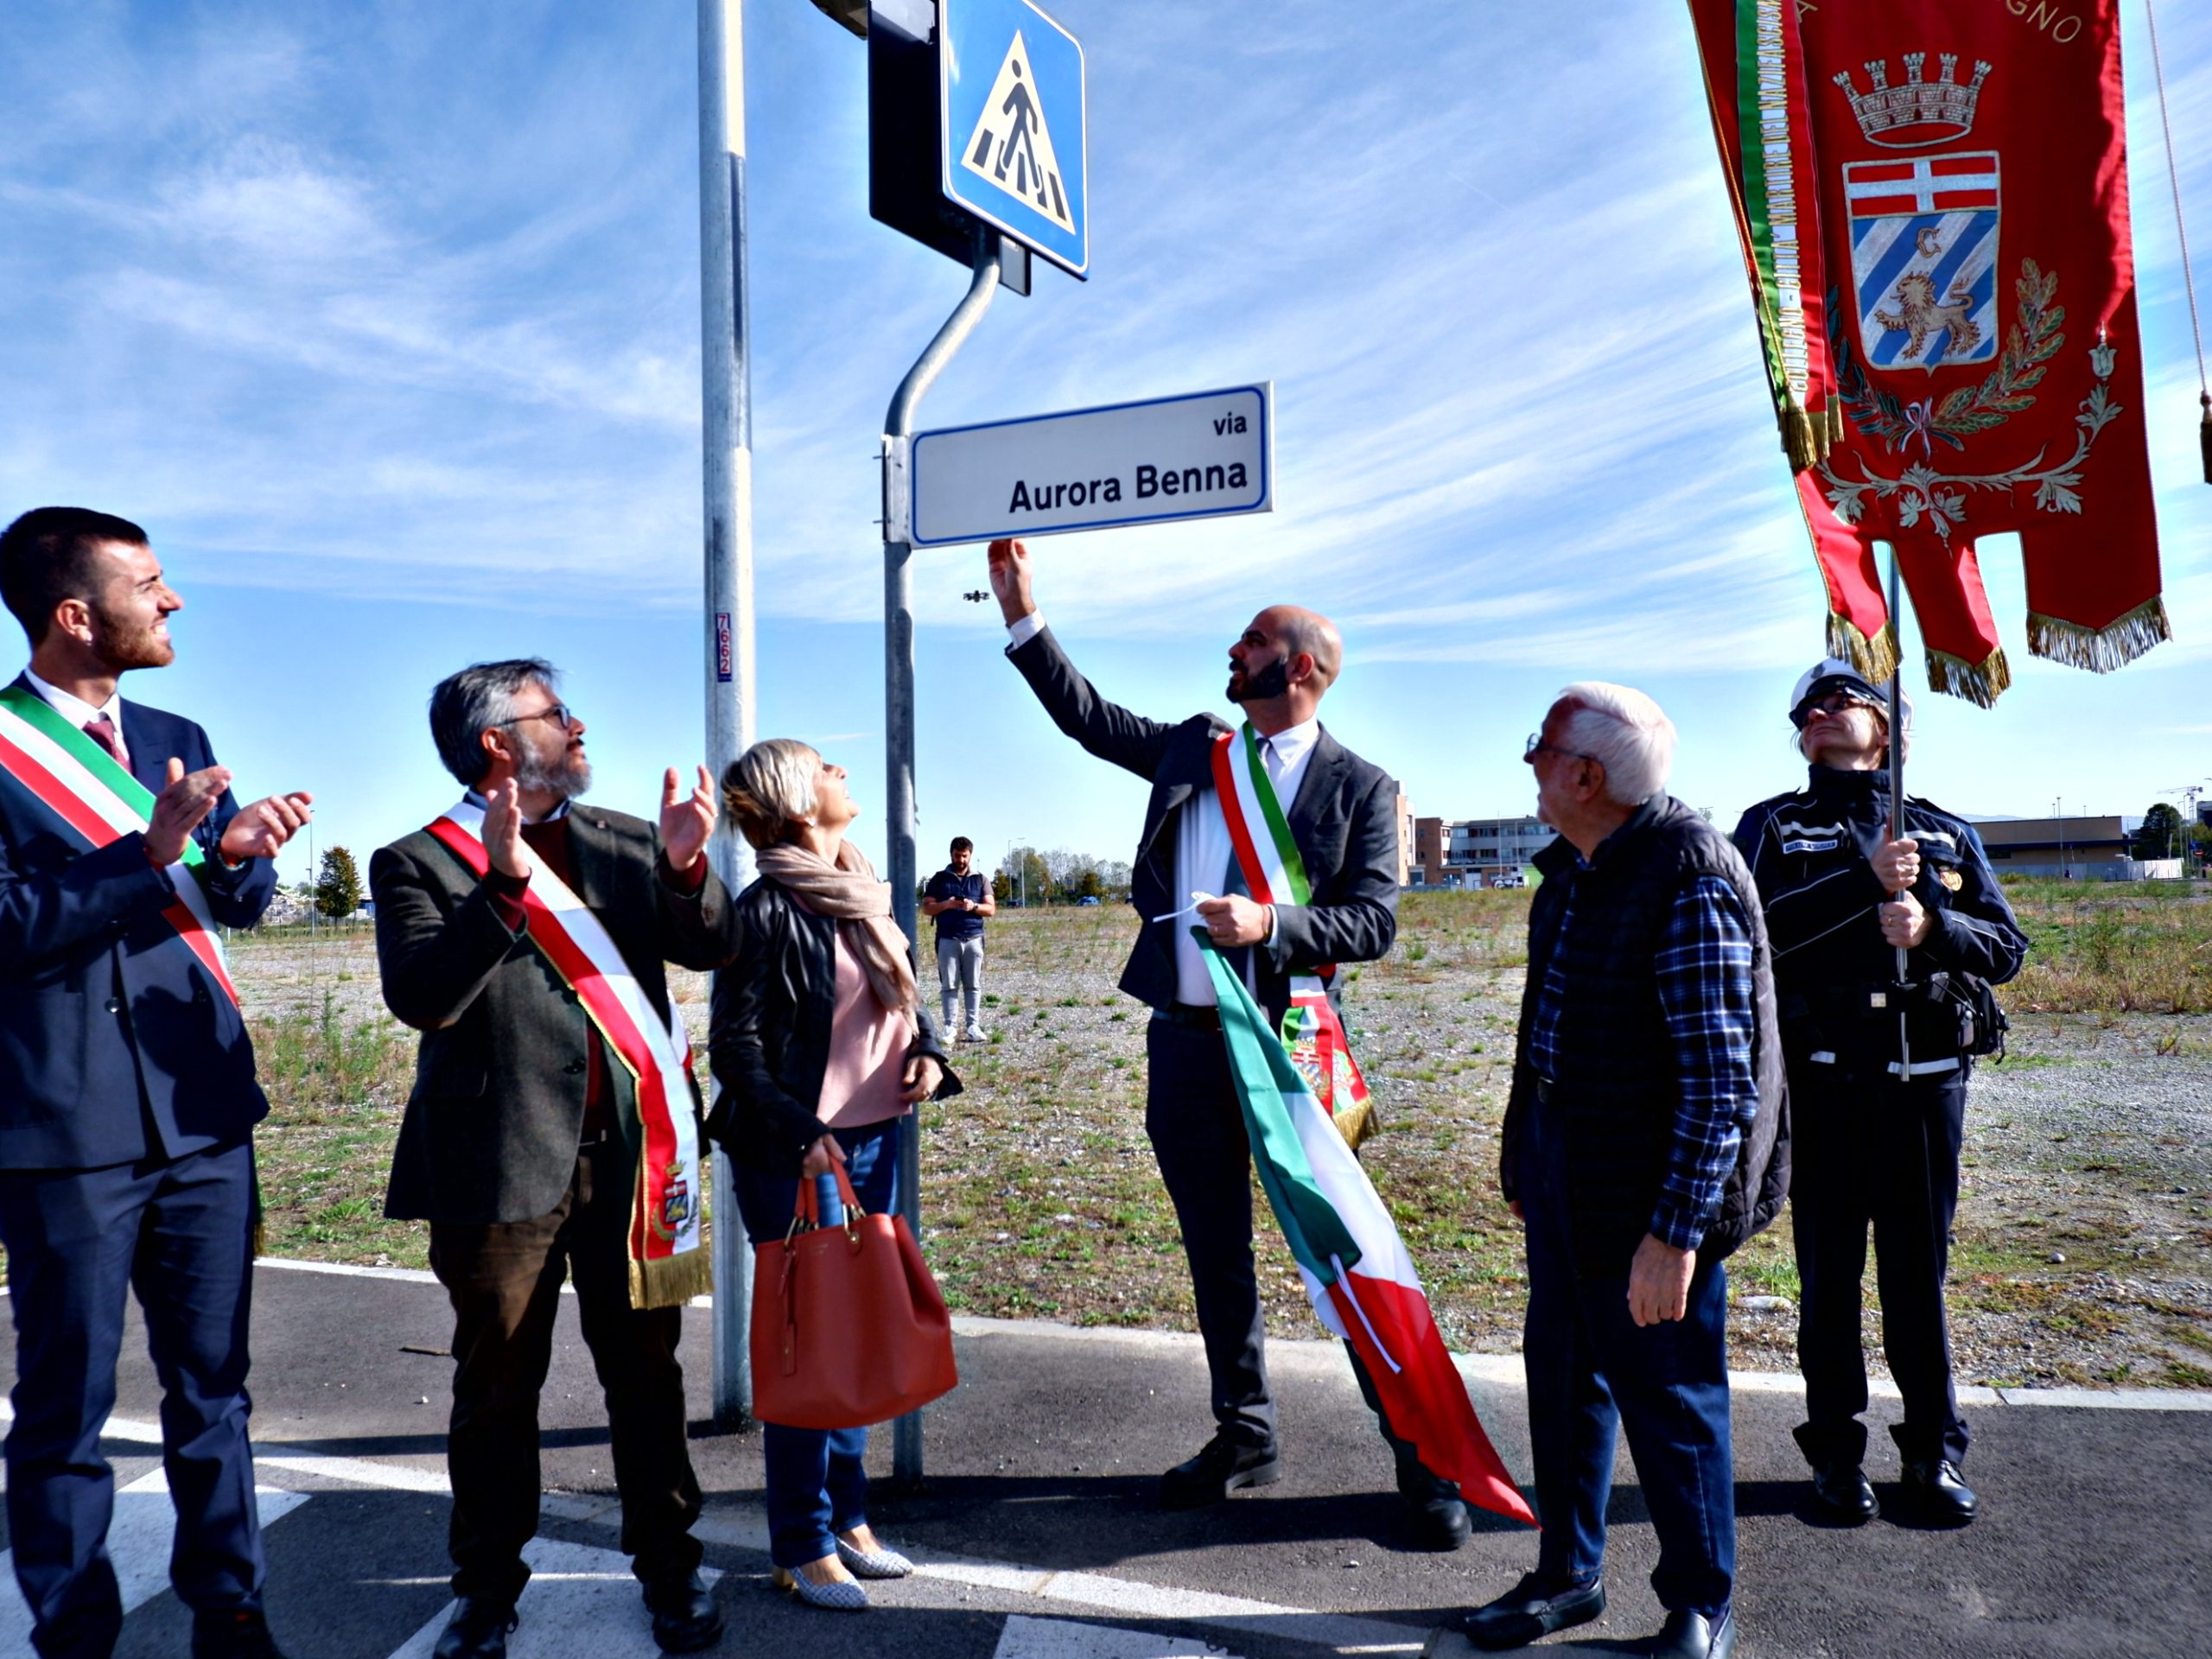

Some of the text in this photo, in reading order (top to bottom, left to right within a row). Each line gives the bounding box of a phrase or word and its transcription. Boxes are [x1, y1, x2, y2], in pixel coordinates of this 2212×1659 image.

[1759, 114, 1791, 145] DEL
[1763, 149, 1798, 226] MARTIRE
[1213, 411, 1247, 435] via
[1009, 461, 1248, 513] Aurora Benna
[718, 614, 729, 672] 7662
